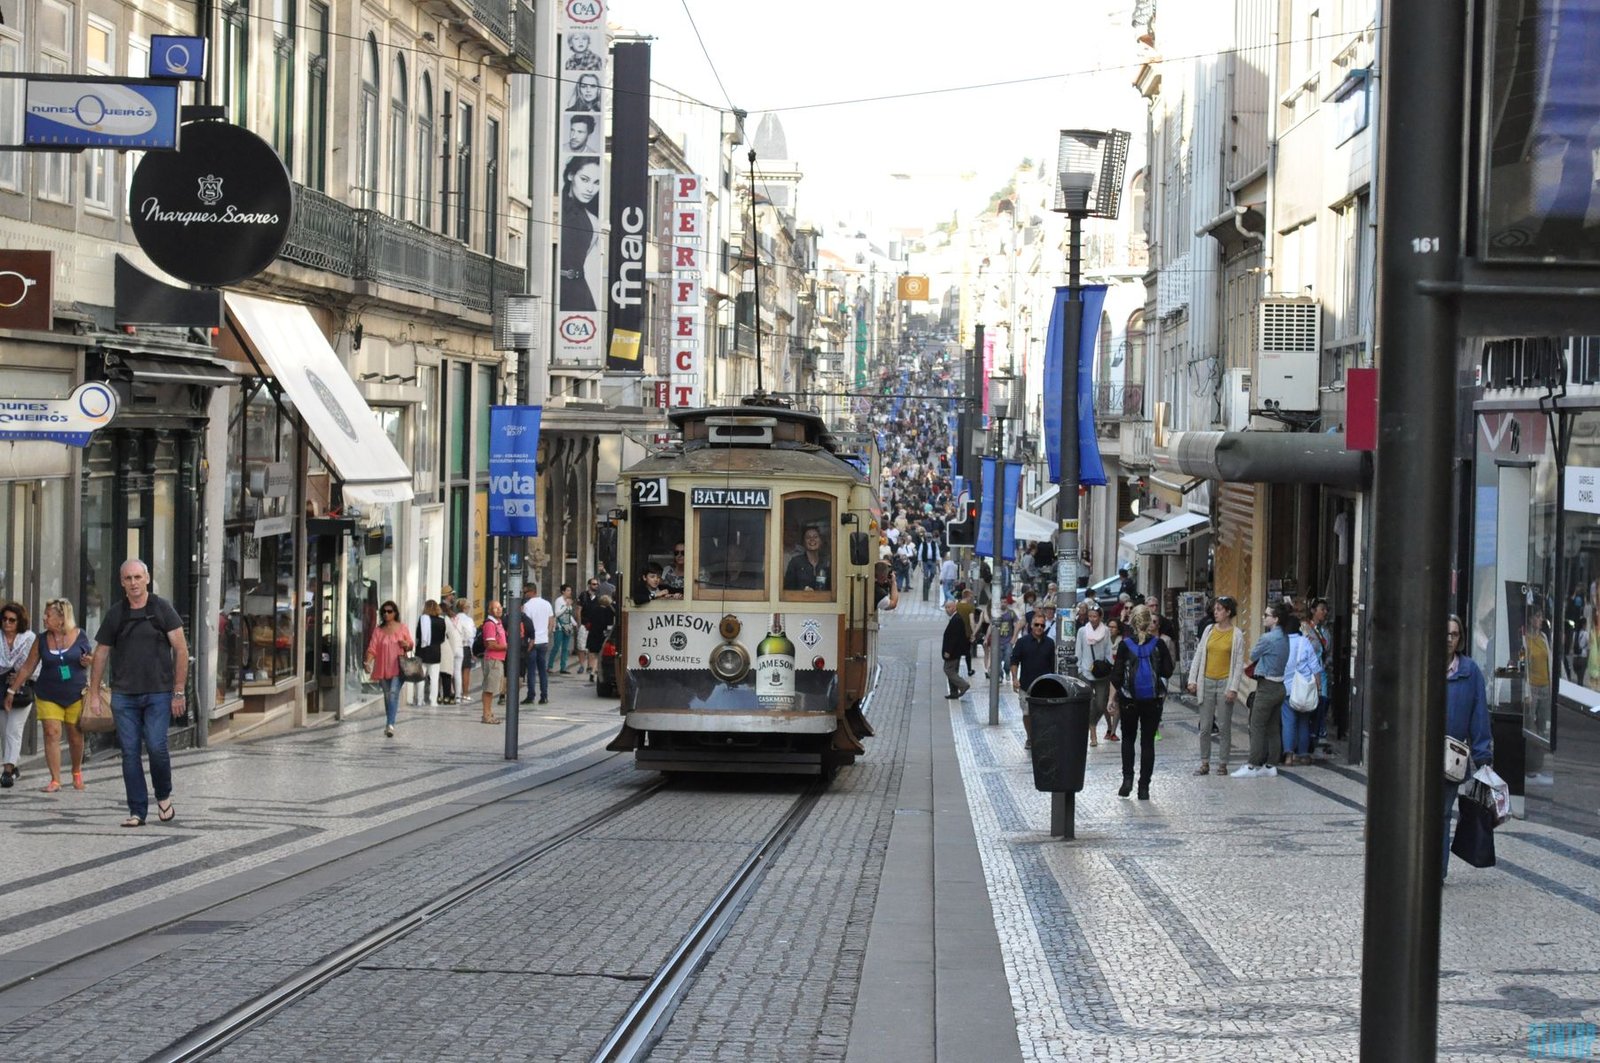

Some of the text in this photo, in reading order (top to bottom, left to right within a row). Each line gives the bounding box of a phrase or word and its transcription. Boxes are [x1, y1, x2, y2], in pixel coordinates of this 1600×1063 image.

[573, 2, 596, 16] C&A
[141, 197, 279, 226] Marques Soares
[1412, 237, 1440, 253] 161
[611, 206, 644, 309] fnac
[675, 178, 697, 406] PERFECT
[566, 322, 590, 336] C&A
[489, 471, 535, 495] vota
[634, 481, 659, 502] 22
[694, 490, 766, 505] BATALHA
[647, 614, 714, 634] JAMESON
[642, 637, 658, 648] 213
[655, 654, 702, 664] CASKMATES
[758, 659, 793, 671] JAMESON
